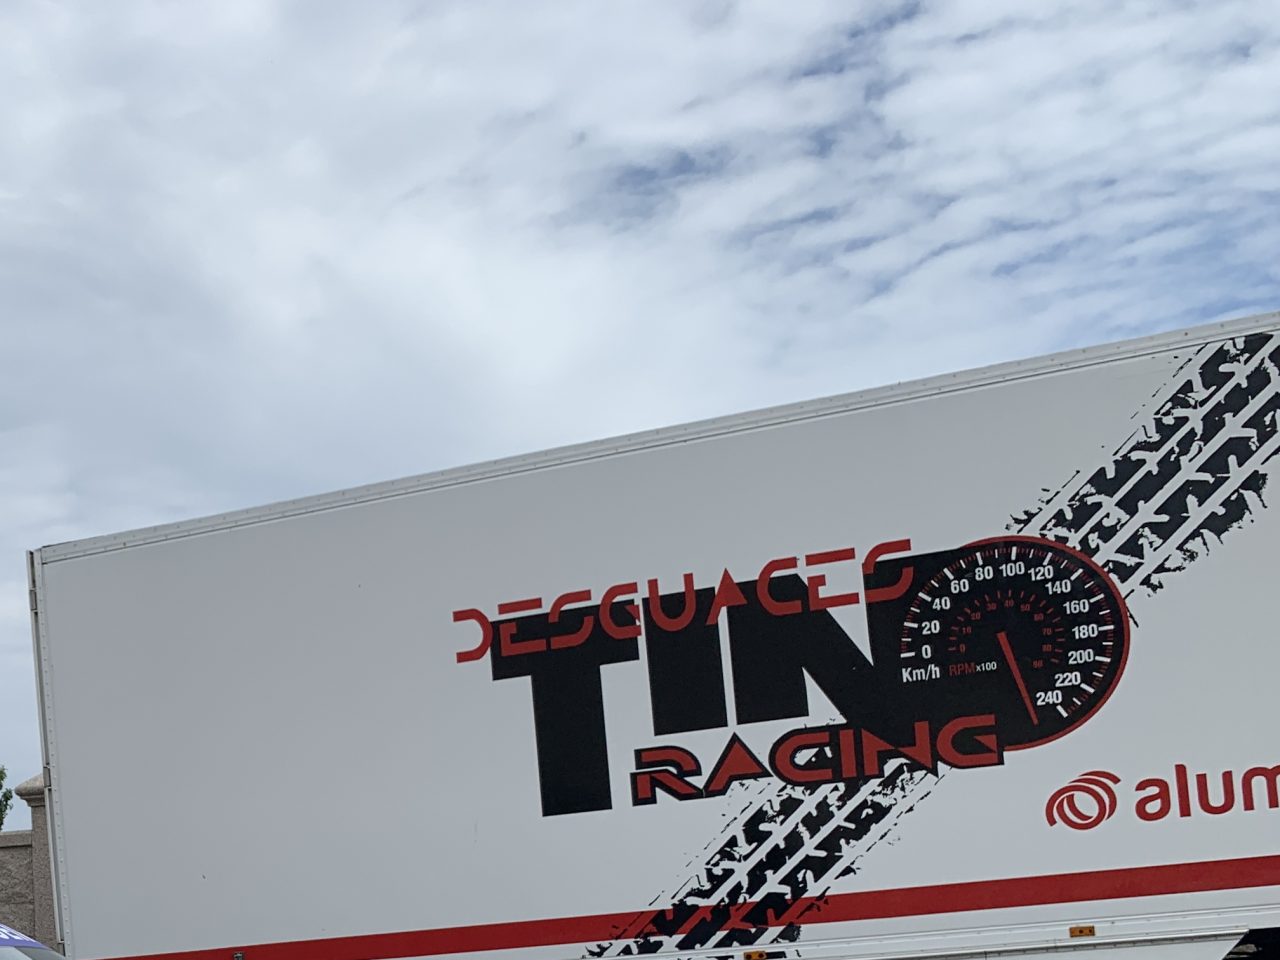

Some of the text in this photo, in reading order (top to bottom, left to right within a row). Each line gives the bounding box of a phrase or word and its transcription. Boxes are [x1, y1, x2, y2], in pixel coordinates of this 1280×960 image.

[975, 566, 994, 581] 80
[999, 561, 1025, 577] 100
[1028, 565, 1054, 582] 120
[950, 578, 970, 594] 60
[1045, 579, 1071, 595] 140
[932, 597, 951, 612] 40
[1063, 599, 1090, 615] 160
[921, 620, 940, 636] 20
[1072, 624, 1098, 640] 180
[921, 645, 932, 659] 0
[1068, 649, 1094, 665] 200
[902, 664, 941, 683] Km/h
[1054, 671, 1081, 687] 220
[1036, 690, 1062, 706] 240
[632, 714, 1004, 805] RACING
